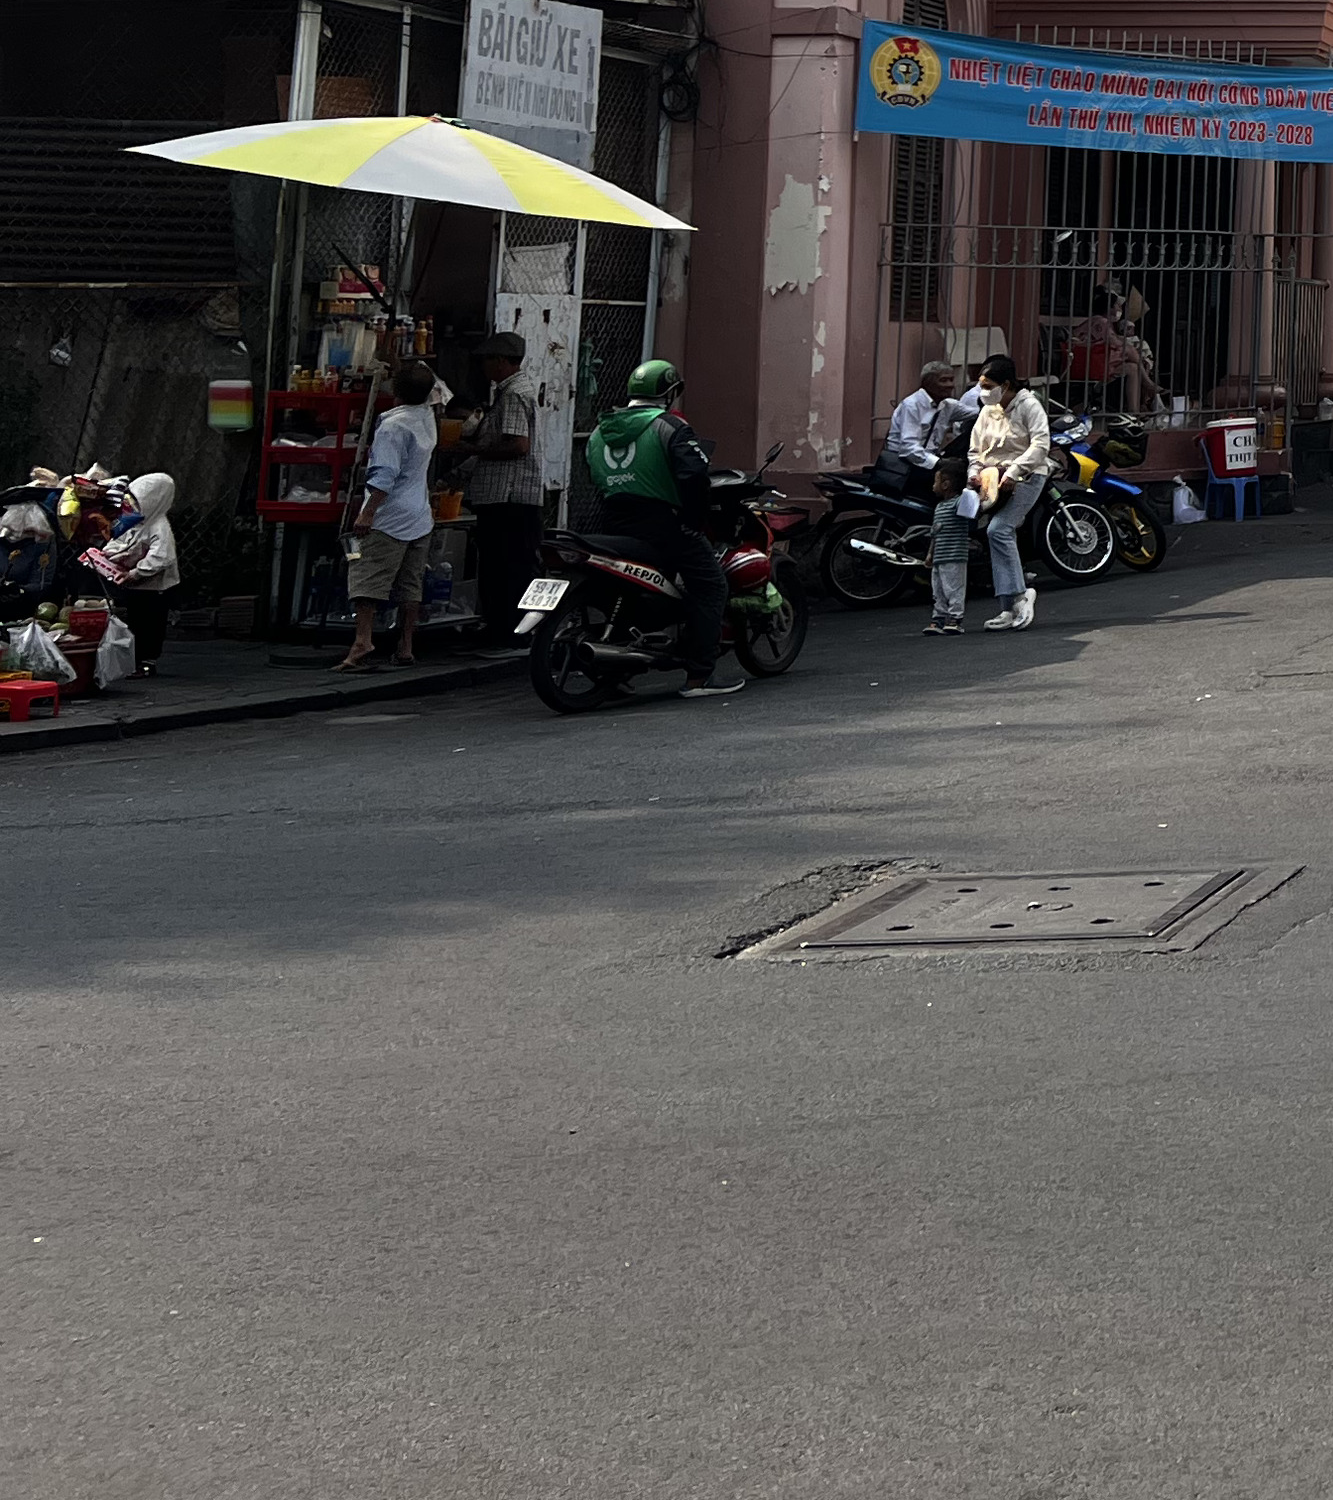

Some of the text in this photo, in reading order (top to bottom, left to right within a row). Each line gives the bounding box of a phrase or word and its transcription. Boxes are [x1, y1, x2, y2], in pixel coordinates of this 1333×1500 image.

[477, 1, 581, 75] BÃI GIỮ XE
[949, 57, 1002, 88] NHIỆT
[1006, 62, 1046, 92] LIỆT
[1049, 65, 1095, 92] CHÀO
[1100, 71, 1149, 98] MỪNG
[1154, 78, 1184, 104] ĐẠI
[1187, 78, 1216, 106] HỘI
[1218, 81, 1260, 107] CÔNG
[1265, 85, 1307, 110] ĐOÀN
[1027, 98, 1063, 128] LẦN
[1068, 106, 1101, 131] THỨ
[1105, 110, 1137, 136] XIII,
[1143, 112, 1196, 141] NHIỆM
[1228, 120, 1314, 146] 2023-2028
[606, 472, 635, 487] gojek
[623, 564, 665, 587] REPSOL
